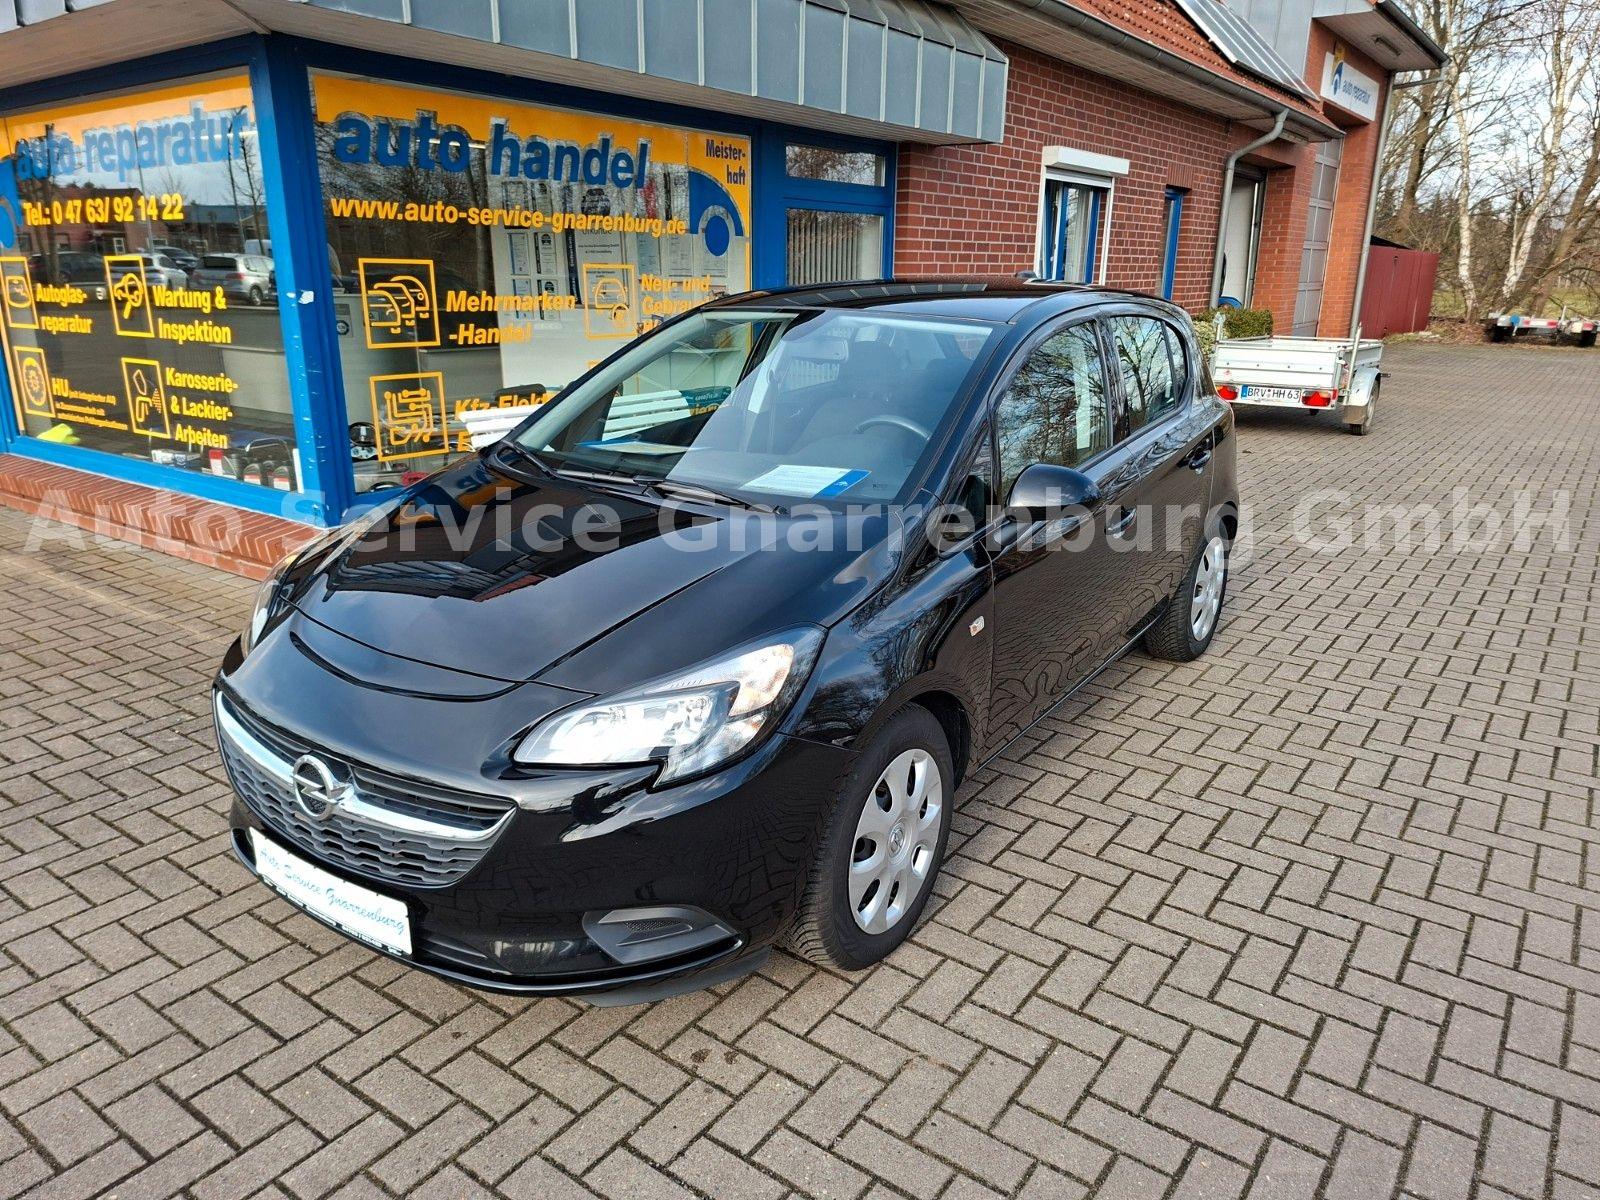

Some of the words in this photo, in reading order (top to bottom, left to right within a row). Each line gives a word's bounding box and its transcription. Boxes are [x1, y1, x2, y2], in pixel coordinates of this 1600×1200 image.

[15, 122, 76, 180] auto
[82, 101, 250, 182] reparatur
[333, 115, 472, 173] auto
[490, 122, 650, 189] handel
[705, 138, 746, 162] Meister-
[726, 164, 746, 186] haft
[23, 202, 51, 226] Tel.:
[53, 201, 63, 225] 0
[65, 200, 81, 224] 47
[86, 198, 109, 224] 63/
[113, 196, 134, 224] 92
[137, 194, 158, 221] 14
[161, 193, 184, 221] 22
[330, 198, 686, 238] www.auto-service-gnarrenburg.de
[35, 283, 88, 307] Autoglas-
[682, 272, 712, 292] und
[152, 285, 211, 314] Wartung
[214, 285, 227, 310] &
[446, 289, 577, 313] Mehrmarken
[39, 314, 92, 335] reparatur
[158, 318, 232, 345] Inspektion
[448, 323, 532, 346] -Handel
[165, 366, 239, 394] Karosserie-
[1247, 387, 1266, 398] BRV
[1272, 389, 1286, 399] HH
[1287, 390, 1300, 400] 63
[170, 395, 180, 413] &
[182, 396, 233, 422] Lackier-
[174, 424, 229, 450] Arbeiten
